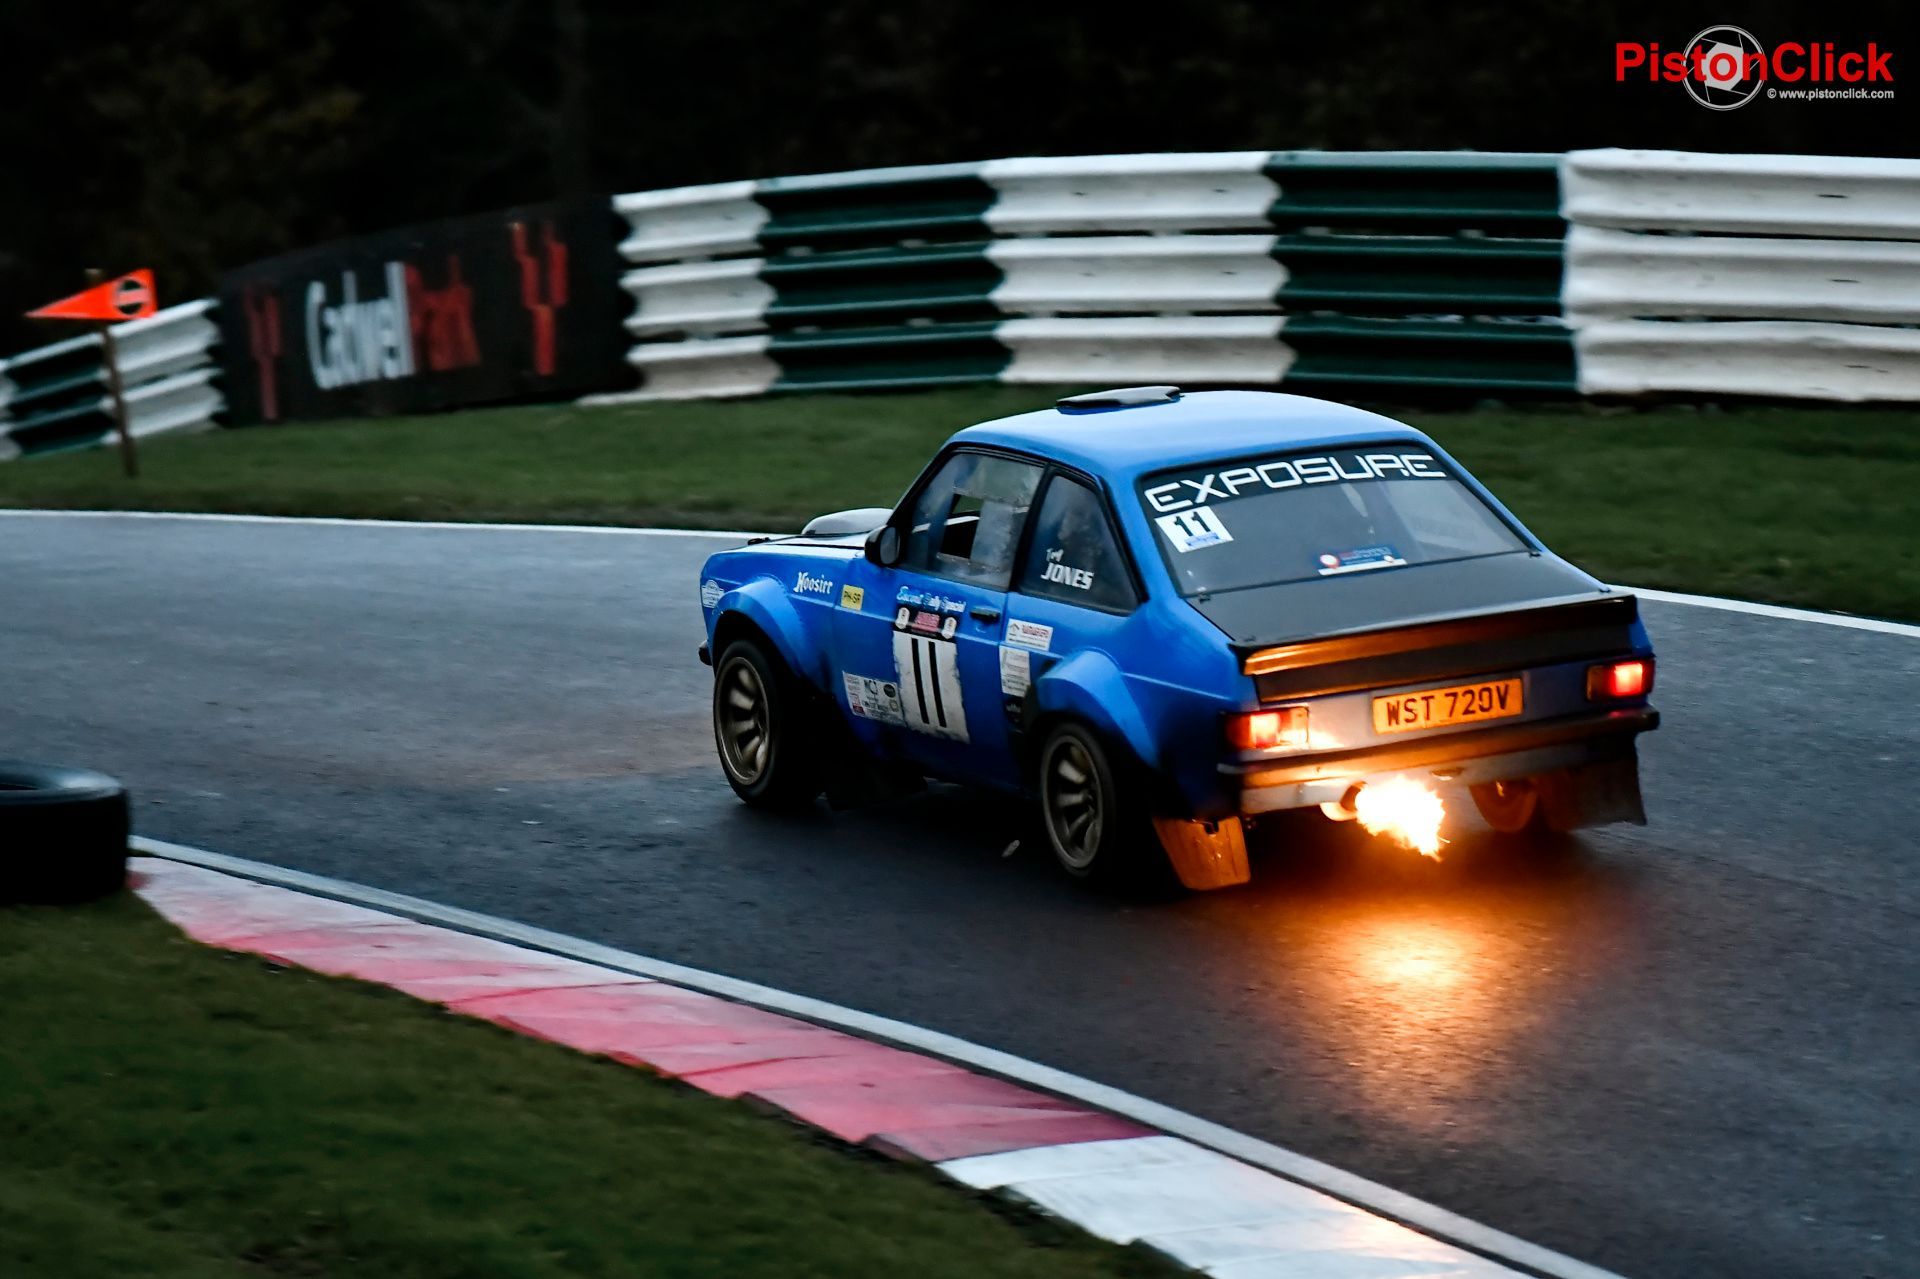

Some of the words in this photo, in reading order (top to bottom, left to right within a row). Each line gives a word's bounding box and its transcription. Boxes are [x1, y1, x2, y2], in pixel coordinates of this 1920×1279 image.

[1144, 454, 1447, 512] EXPOSURE
[1174, 511, 1211, 537] 11
[1040, 562, 1095, 590] JONES
[1386, 695, 1435, 727] WST
[1445, 684, 1510, 718] 720V
